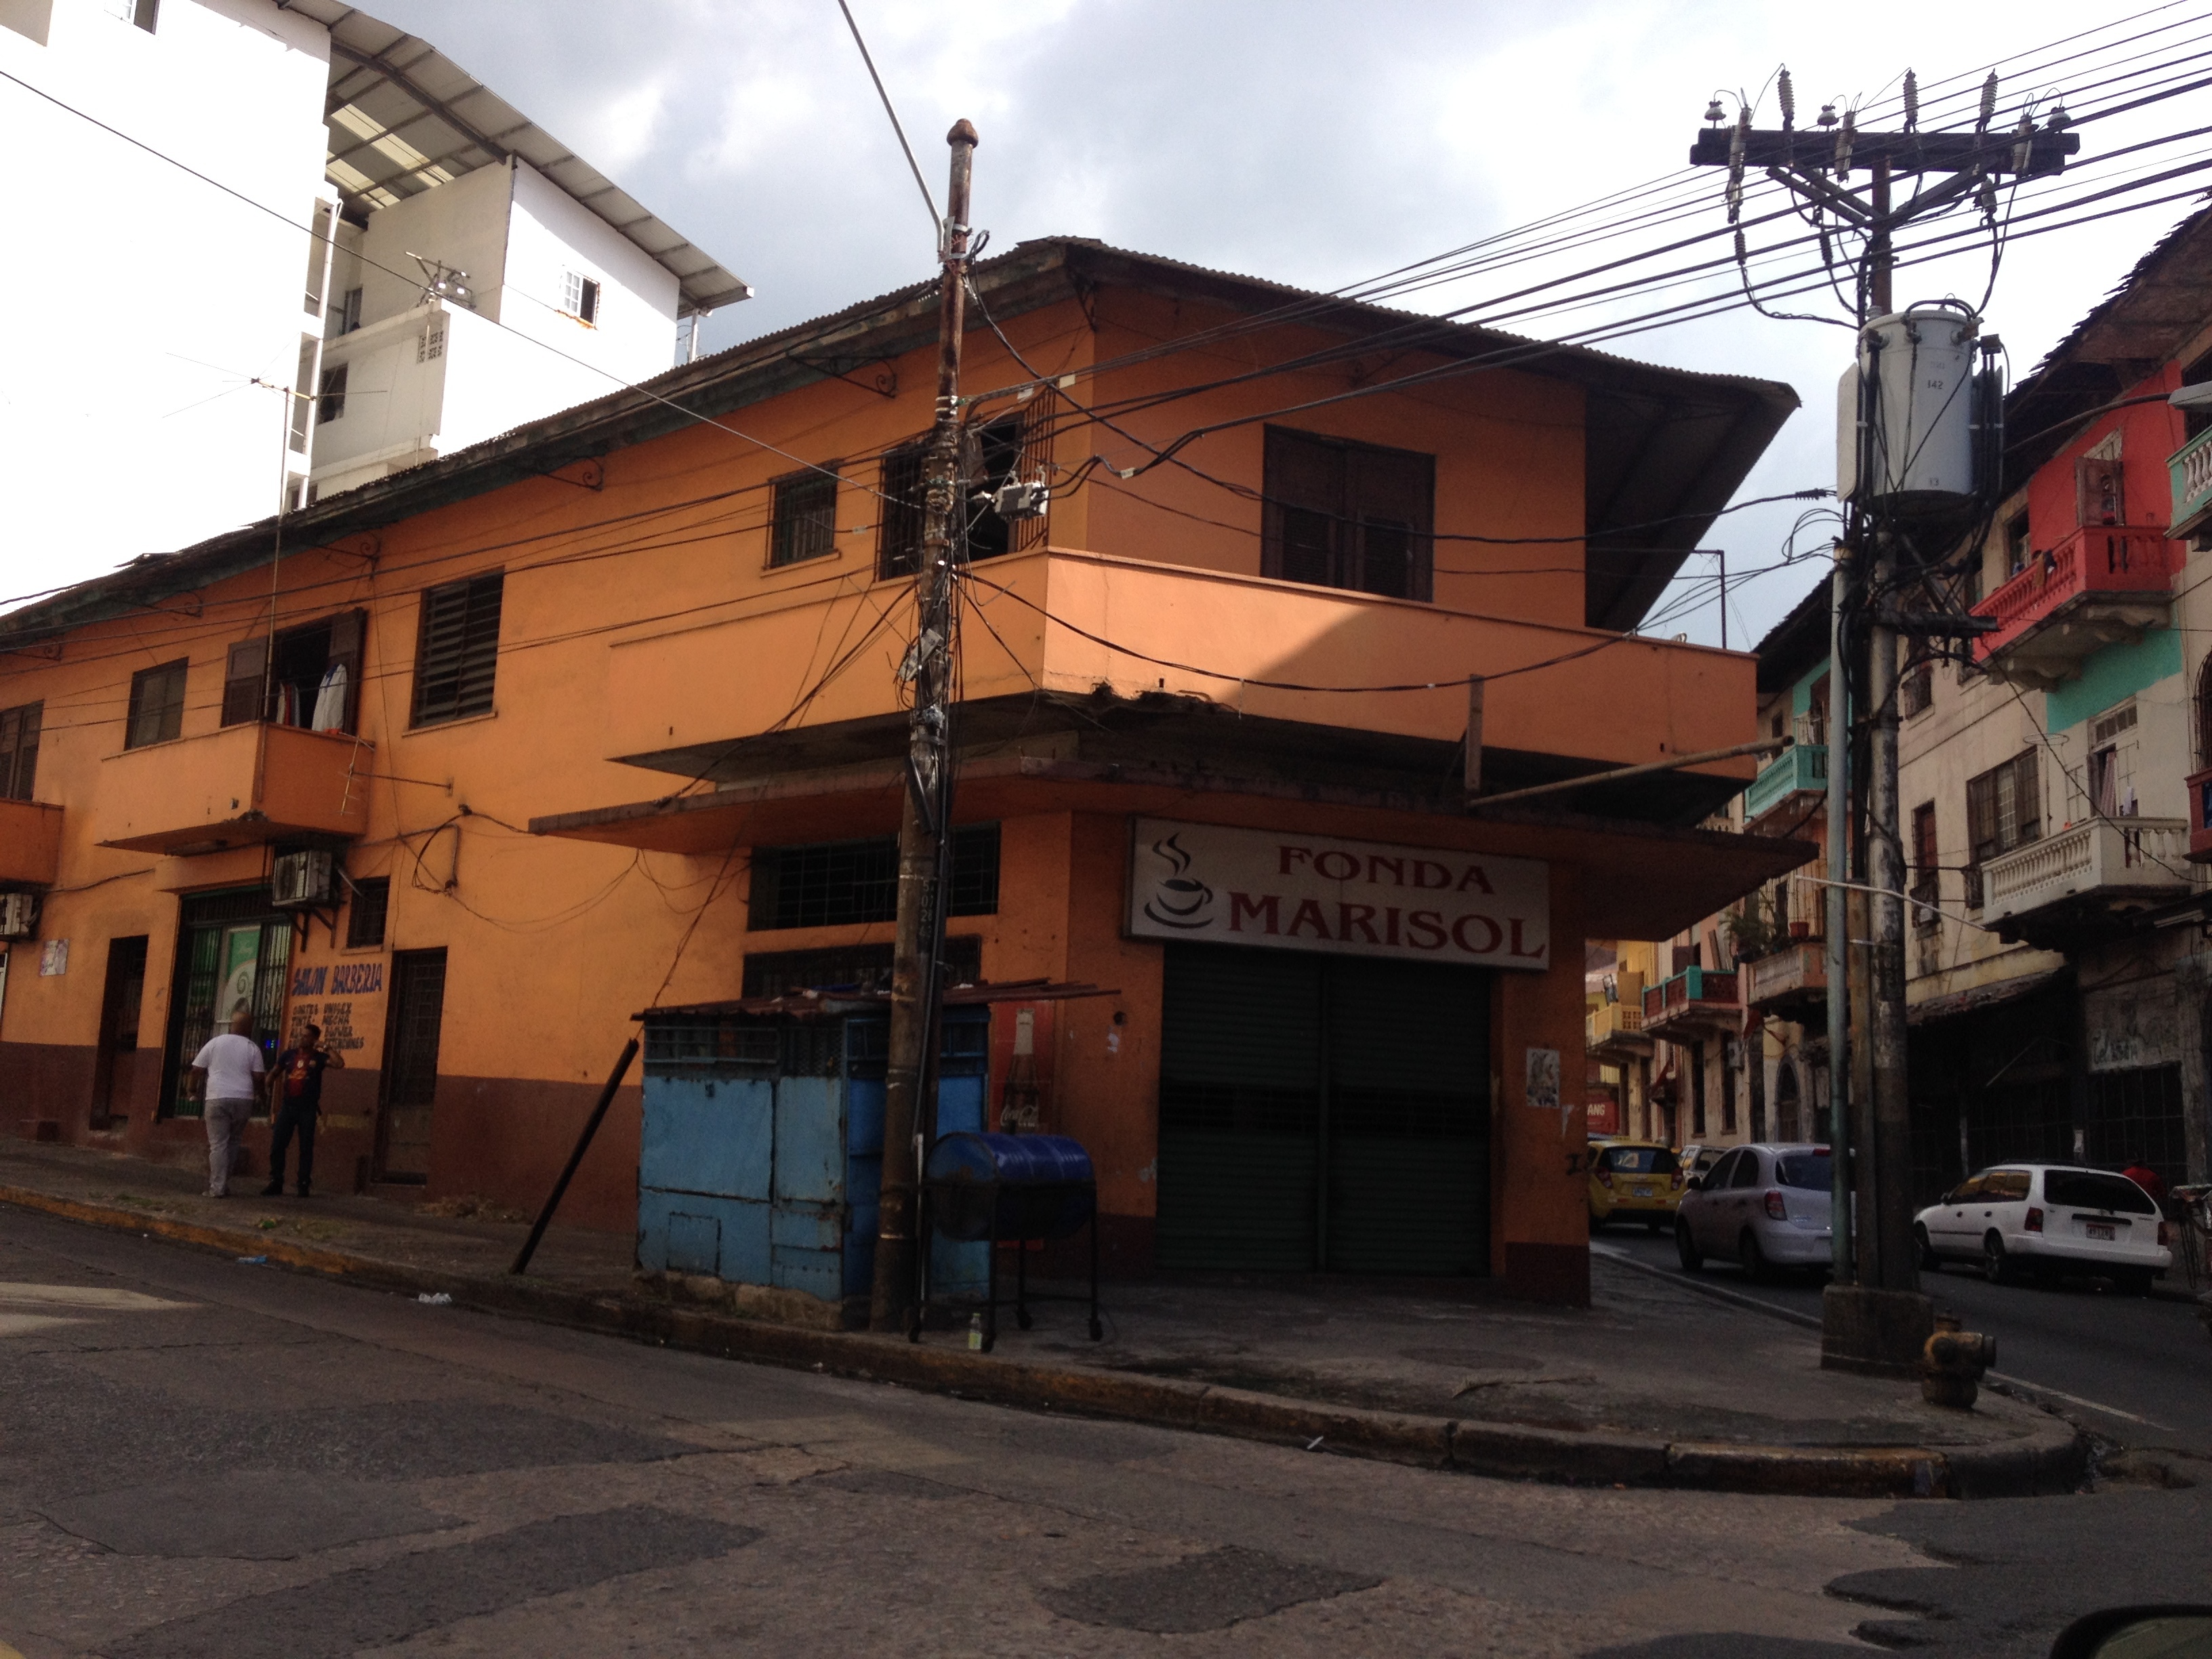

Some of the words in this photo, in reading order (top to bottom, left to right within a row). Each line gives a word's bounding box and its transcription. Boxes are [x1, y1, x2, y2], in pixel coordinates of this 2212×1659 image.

[1927, 381, 1944, 390] 142
[1277, 844, 1496, 895] FONDA
[1227, 890, 1547, 960] MARISOL
[291, 966, 329, 996] SALON
[331, 962, 383, 995] BARBERIA
